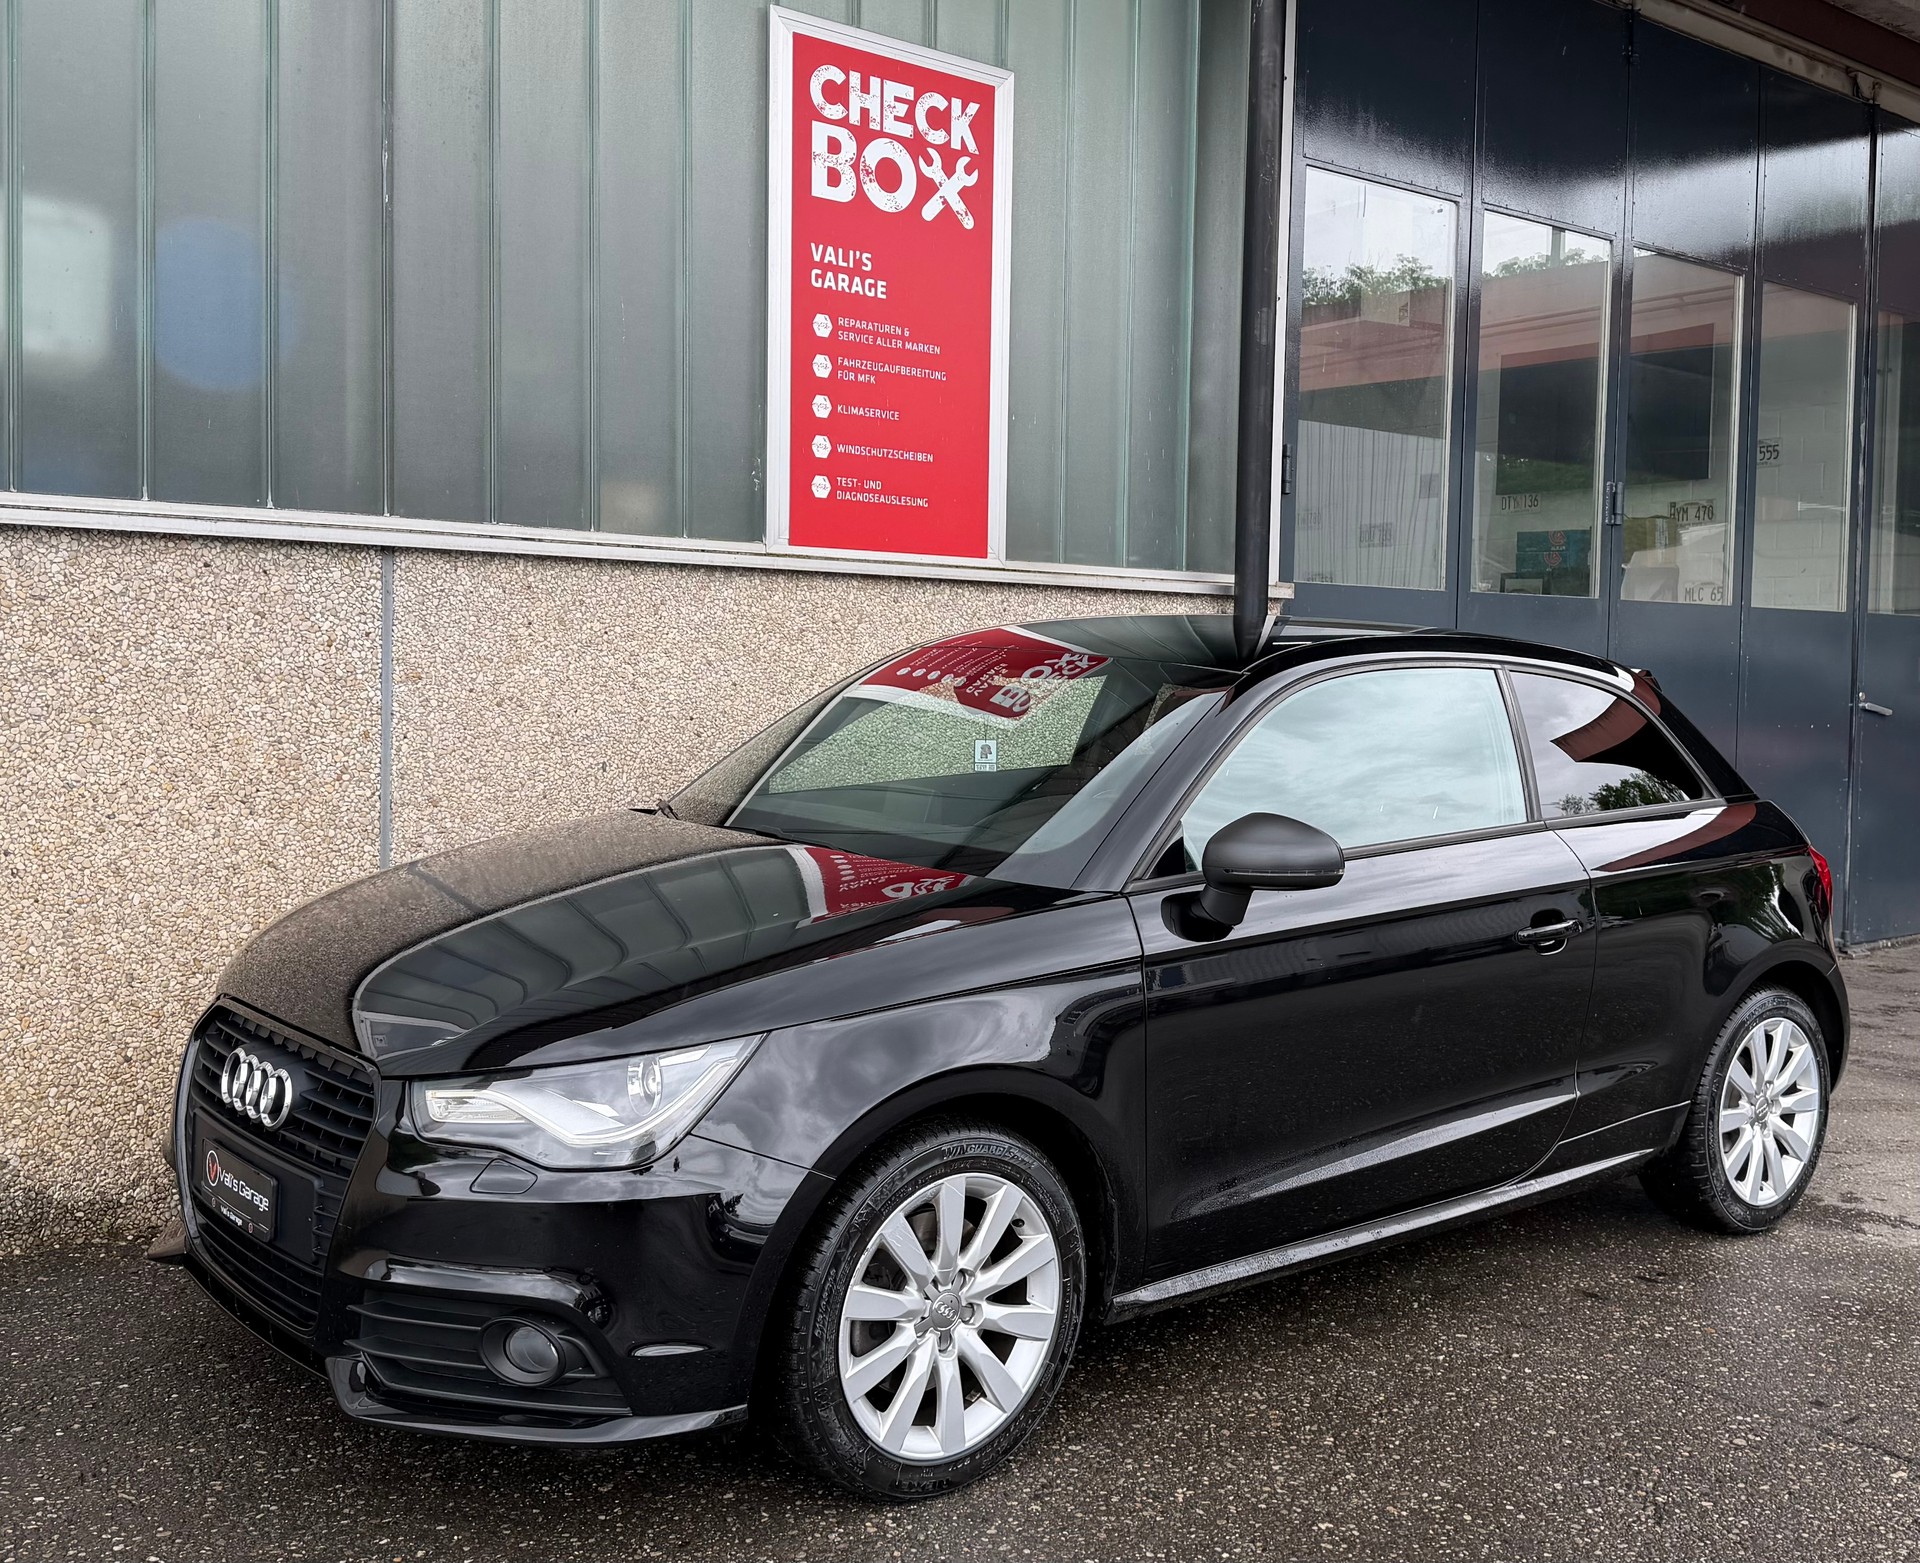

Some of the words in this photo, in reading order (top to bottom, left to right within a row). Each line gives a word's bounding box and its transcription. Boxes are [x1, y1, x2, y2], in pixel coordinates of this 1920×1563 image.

[809, 64, 980, 155] CHECK
[811, 120, 979, 230] BOX
[810, 242, 872, 271] VALI'S
[811, 269, 887, 299] GARAGE
[838, 317, 902, 336] REPARATUREN
[904, 327, 910, 337] &
[838, 330, 874, 345] SERVICE
[876, 336, 903, 349] ALLER
[905, 341, 941, 355] MARKEN
[837, 356, 947, 381] FAHRZEUGAUFBEREITUNG
[837, 370, 855, 382] FÜR
[857, 374, 876, 384] MFK
[837, 404, 900, 421] KLIMASERVICE
[836, 443, 934, 463] WINDSCHUTZSCHEIBEN
[1759, 444, 1780, 461] 555
[836, 477, 862, 488] TEST-
[863, 480, 882, 490] UND
[836, 490, 929, 508] DIAGNOSEAUSLESUNG
[1523, 494, 1539, 508] 136
[1694, 504, 1714, 521] 470
[239, 1181, 269, 1212] Garage
